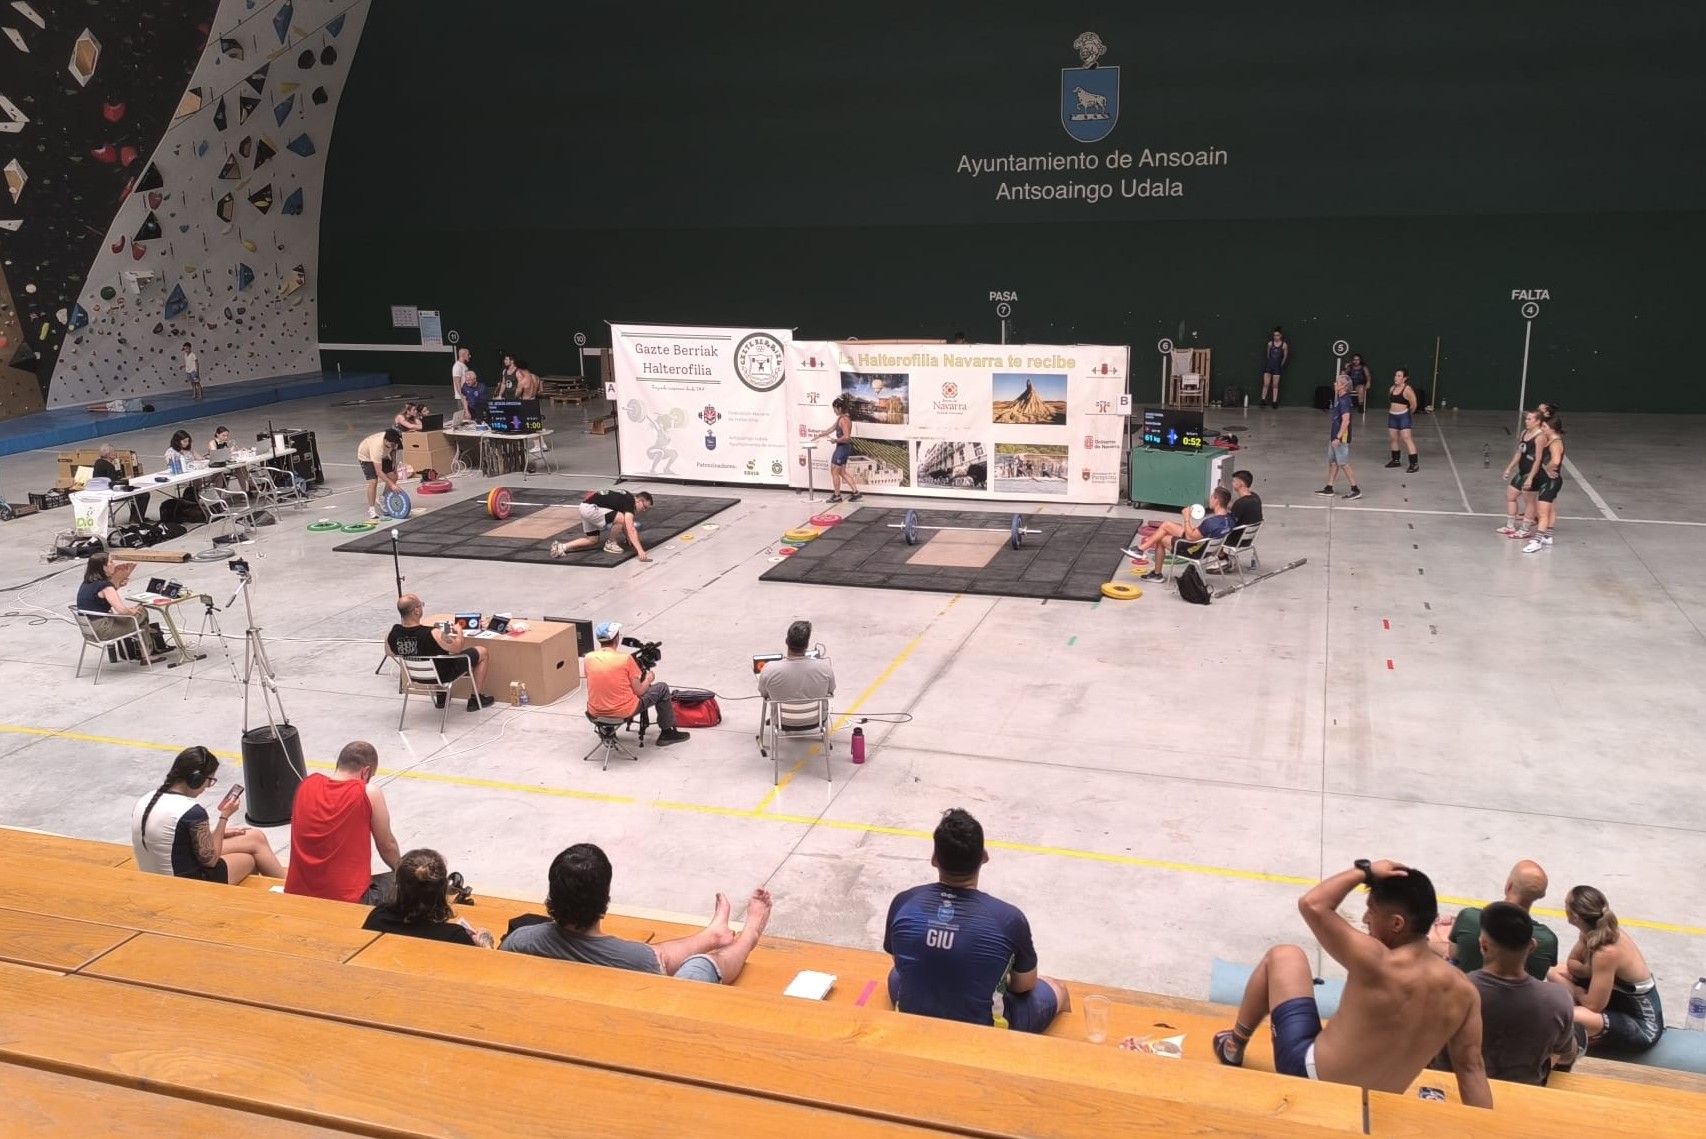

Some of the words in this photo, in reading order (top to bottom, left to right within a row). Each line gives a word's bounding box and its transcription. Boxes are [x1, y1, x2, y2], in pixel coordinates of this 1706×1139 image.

[957, 152, 1099, 177] Ayuntamiento
[1106, 150, 1132, 168] de
[1138, 146, 1228, 168] Ansoain
[996, 181, 1113, 203] Antsoaingo
[1121, 178, 1183, 198] Udala
[989, 291, 1018, 301] PASA
[1511, 289, 1550, 300] FALTA
[1526, 306, 1534, 314] 4
[635, 343, 670, 355] Gazte
[673, 344, 719, 357] Berriak
[1162, 342, 1169, 350] 6
[838, 352, 855, 366] La
[858, 353, 939, 367] Halterofilia
[943, 354, 1003, 368] Navarra
[1007, 354, 1022, 368] te
[1027, 355, 1076, 369] recibe
[643, 362, 712, 376] Halterofilia
[608, 383, 616, 393] A
[933, 401, 967, 410] Navarra
[1120, 396, 1128, 406] B
[526, 422, 541, 430] 1:00
[1182, 436, 1202, 447] 0:52
[926, 929, 955, 950] GIU
